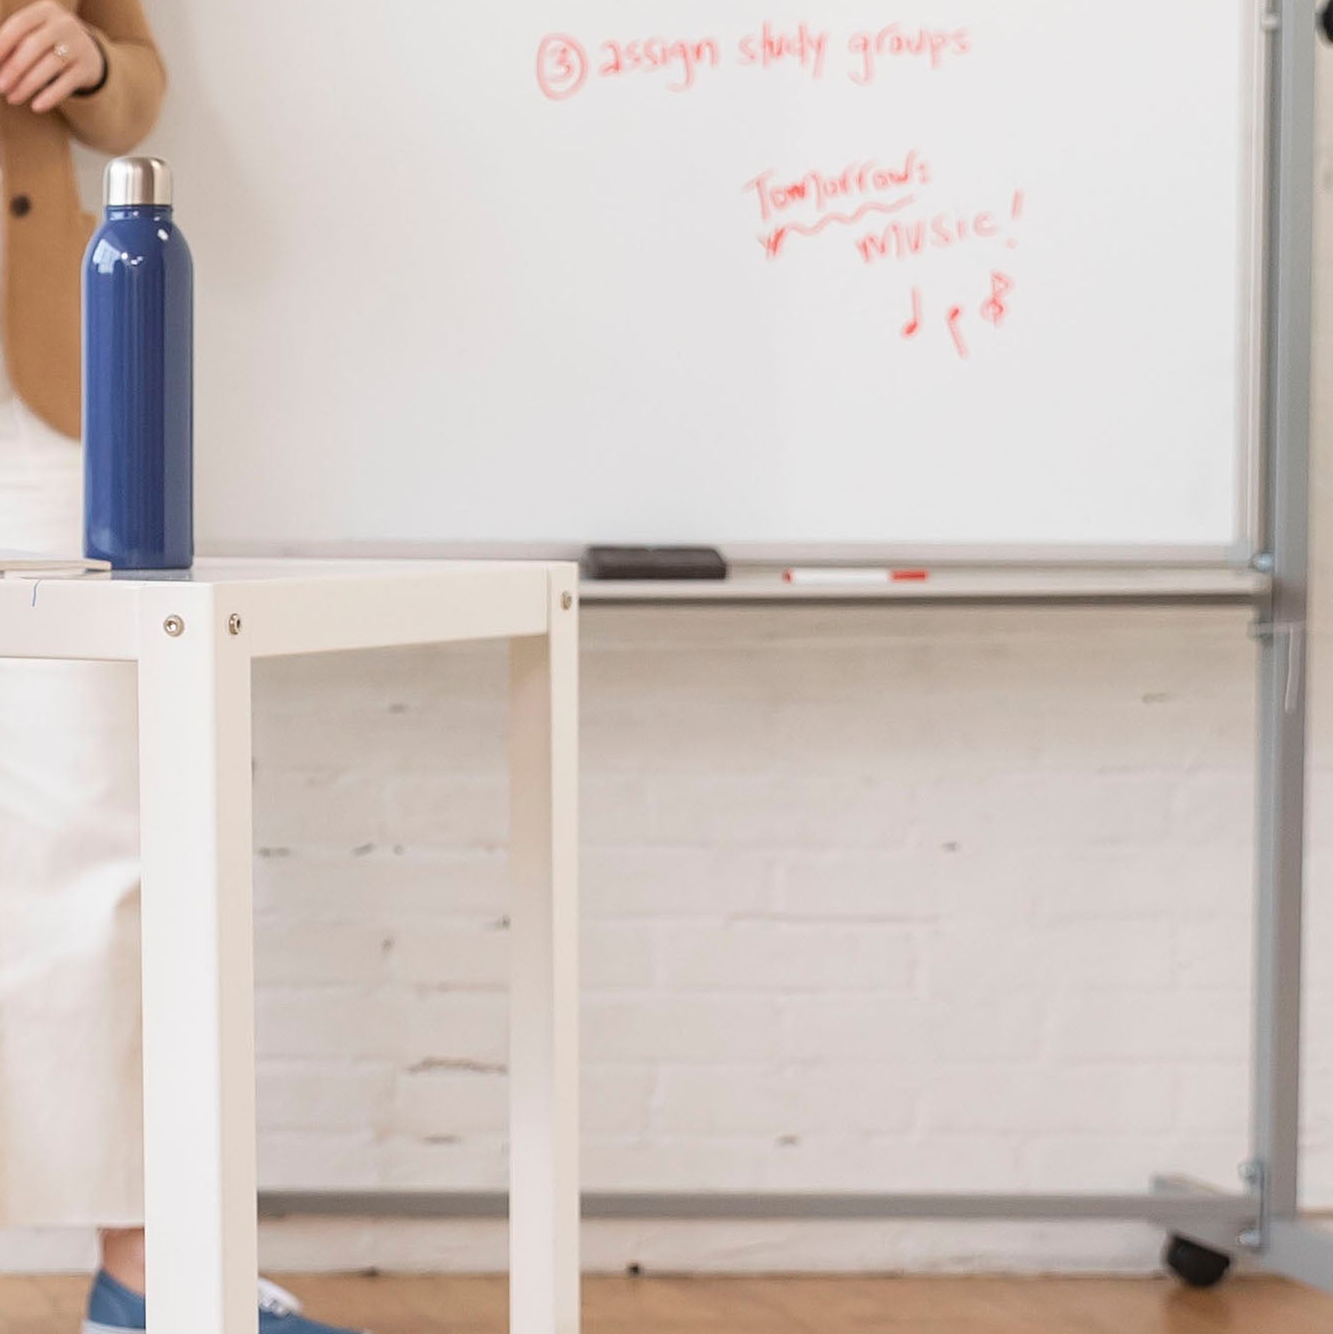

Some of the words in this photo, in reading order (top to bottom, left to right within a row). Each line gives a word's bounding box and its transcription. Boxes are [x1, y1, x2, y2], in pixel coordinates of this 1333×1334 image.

[598, 33, 721, 94] assign
[737, 20, 829, 80] study
[848, 21, 973, 86] groups
